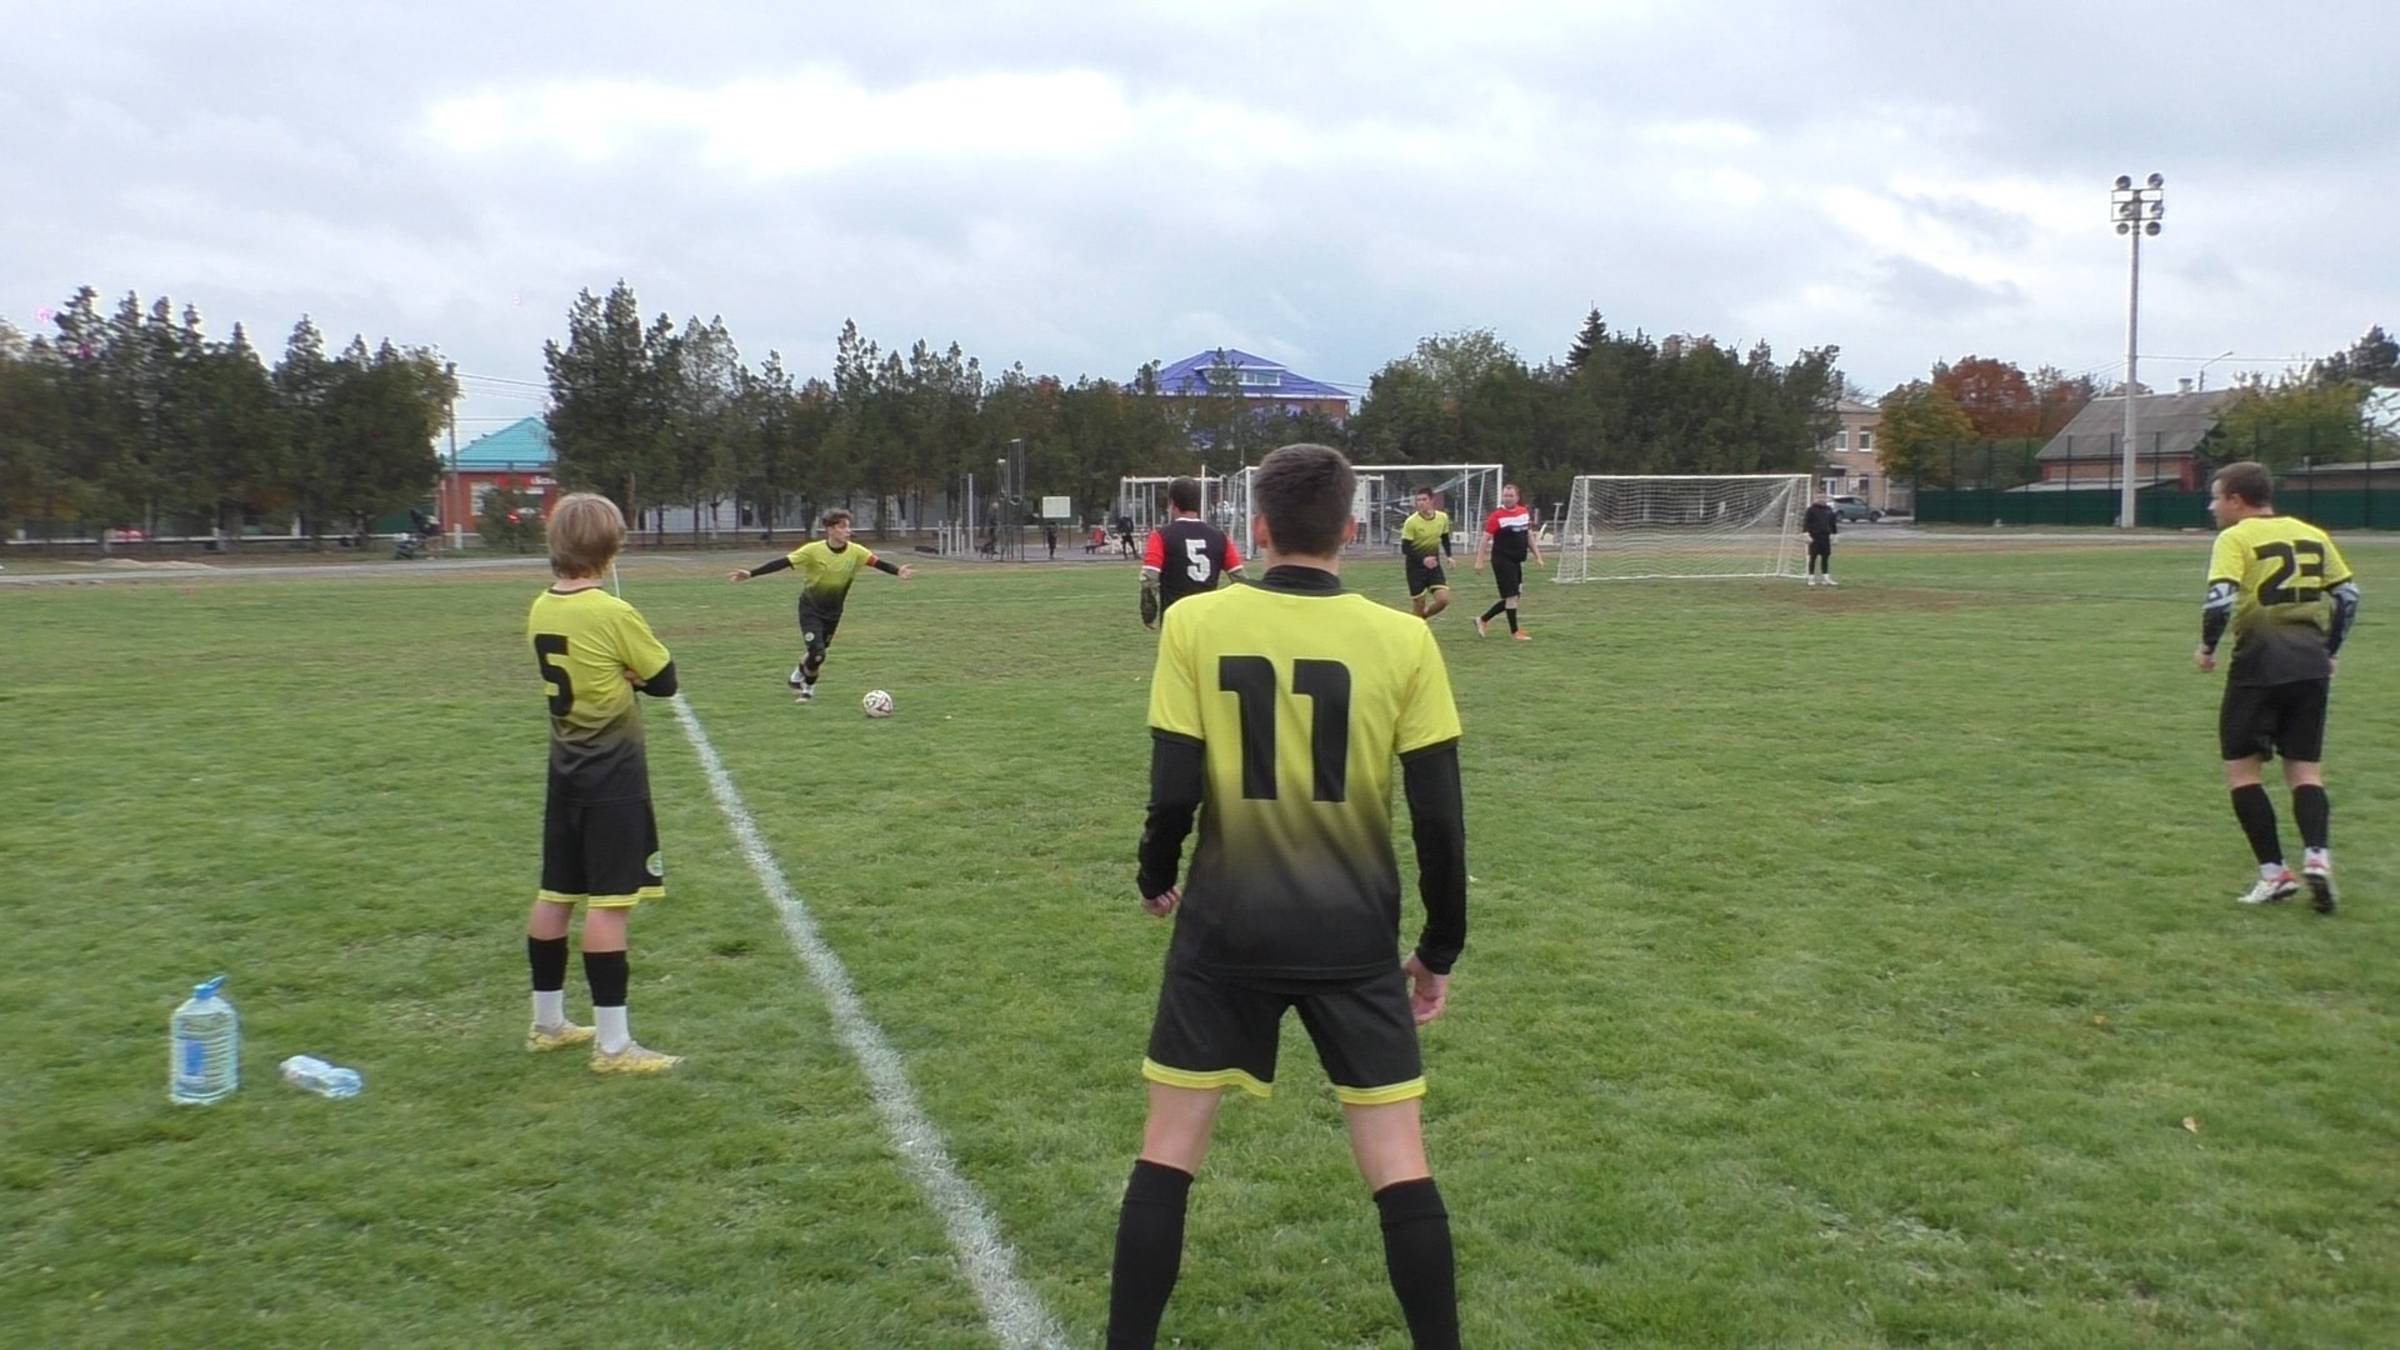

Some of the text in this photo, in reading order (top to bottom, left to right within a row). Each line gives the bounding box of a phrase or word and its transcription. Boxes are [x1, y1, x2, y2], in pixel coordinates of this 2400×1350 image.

[1185, 539, 1211, 582] 5
[2253, 539, 2325, 606] 23
[534, 634, 574, 717] 5
[1218, 655, 1351, 803] 11
